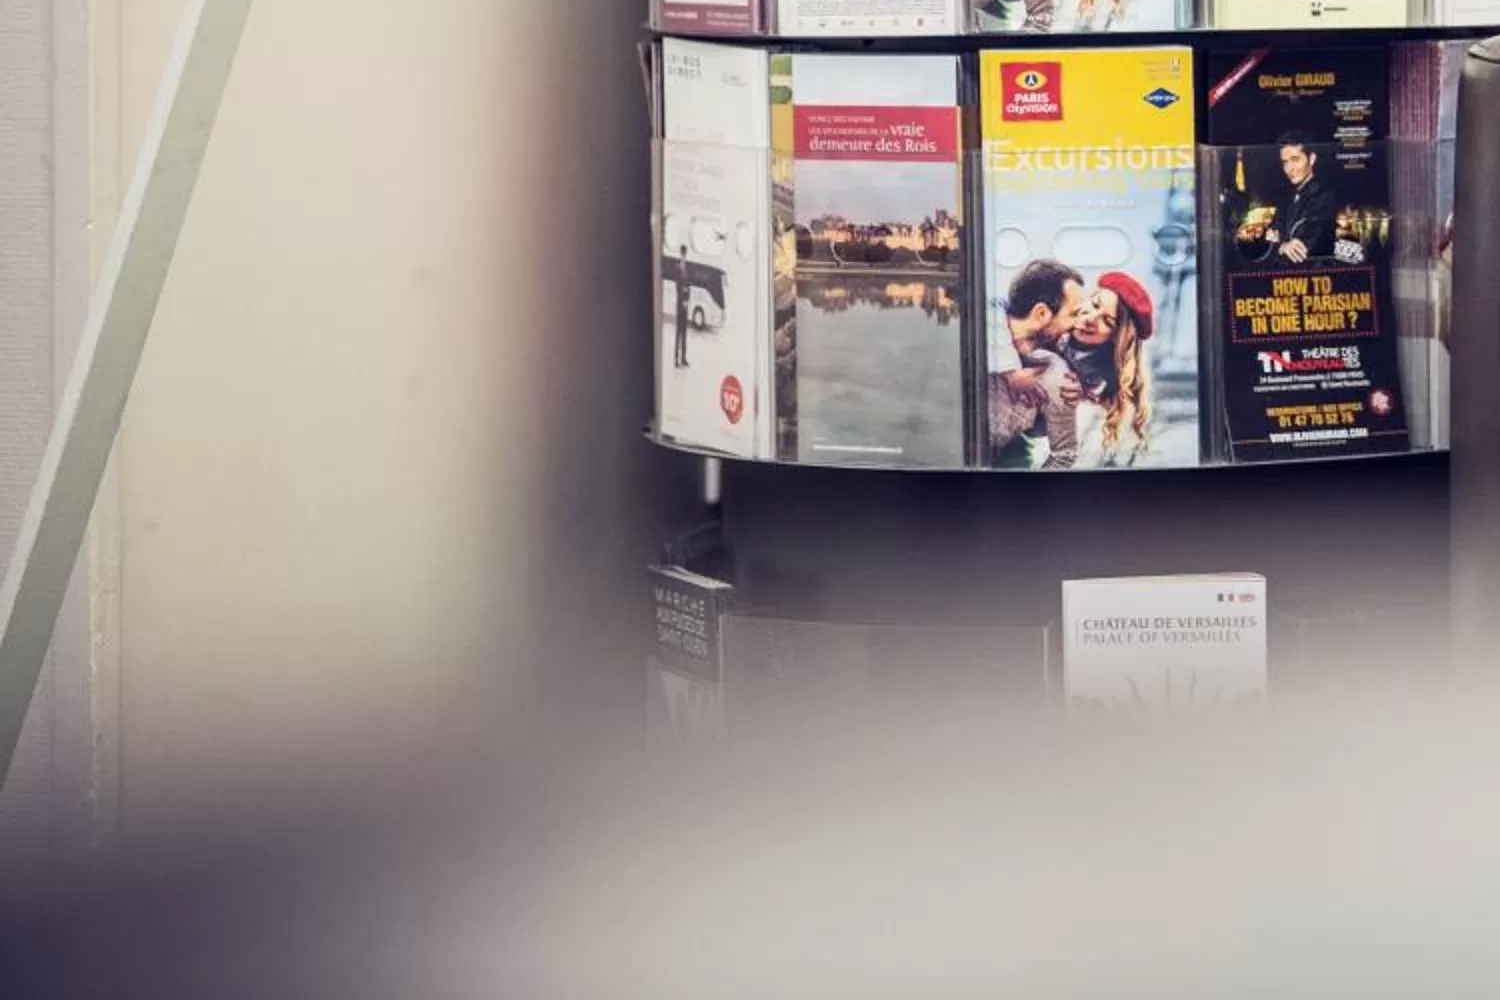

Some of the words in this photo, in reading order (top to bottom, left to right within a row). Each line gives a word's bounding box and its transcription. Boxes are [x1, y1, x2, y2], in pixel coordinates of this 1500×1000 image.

[1015, 93, 1049, 103] PARIS
[889, 122, 926, 137] vraie
[809, 136, 873, 152] demeure
[876, 139, 901, 153] des
[905, 139, 937, 153] Rois
[991, 137, 1194, 172] Excursions
[1272, 278, 1308, 297] HOW
[1311, 276, 1332, 294] TO
[1235, 297, 1300, 317] BECOME
[1303, 293, 1371, 313] PARISIAN
[1251, 317, 1268, 335] IN
[1271, 315, 1301, 333] ONE
[1304, 312, 1345, 332] HOUR
[1350, 312, 1359, 328] ?
[1154, 617, 1173, 629] DE
[1174, 615, 1258, 629] VERSAILLES
[1083, 631, 1133, 645] PALACE
[1139, 631, 1158, 644] OF
[1164, 631, 1241, 644] VERSAILLES
